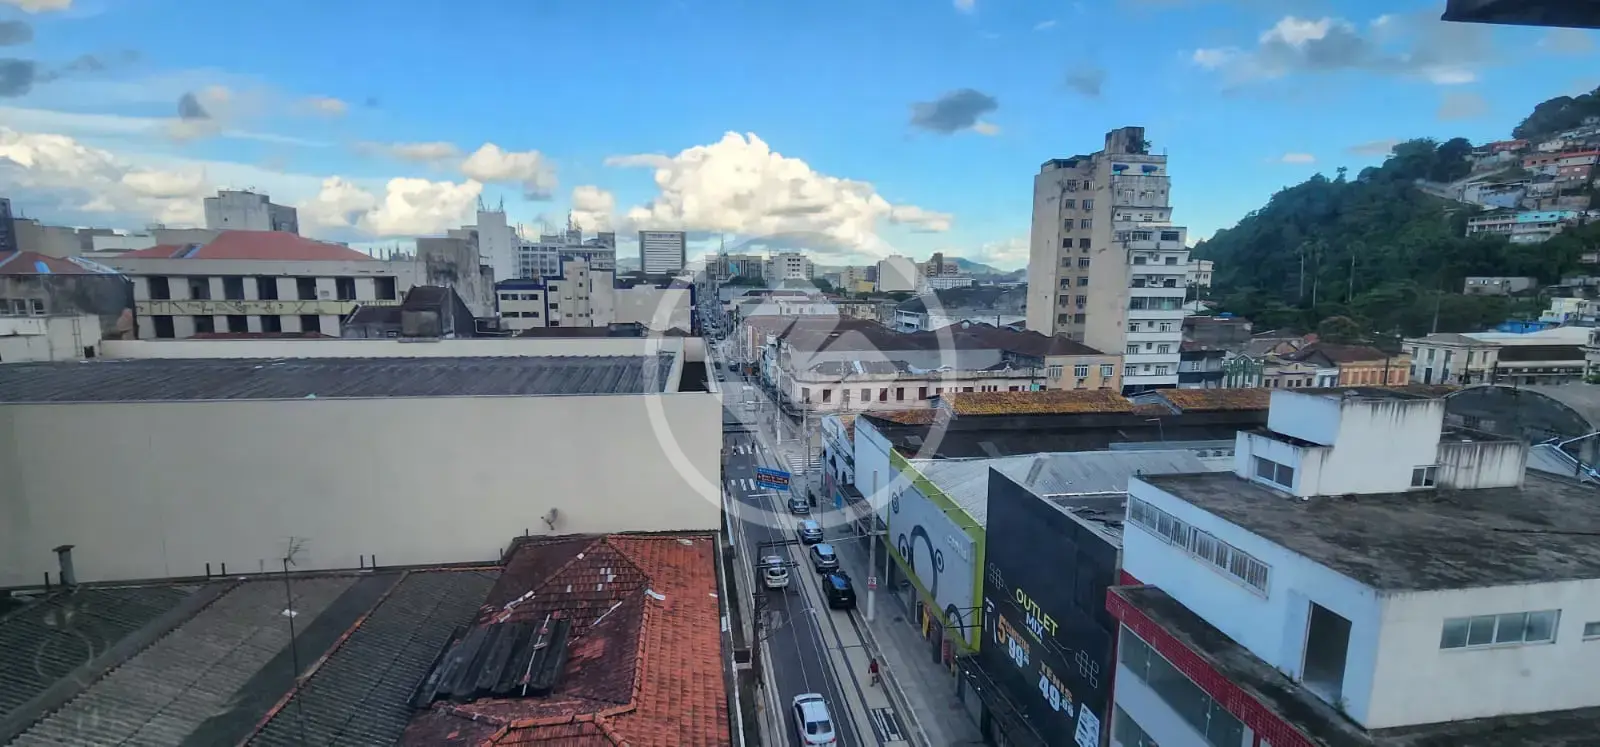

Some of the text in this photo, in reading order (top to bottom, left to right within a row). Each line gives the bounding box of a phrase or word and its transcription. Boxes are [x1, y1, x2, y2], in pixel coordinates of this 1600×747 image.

[1016, 588, 1058, 636] OUTLET
[1026, 612, 1043, 640] MIX
[997, 613, 1006, 644] 5
